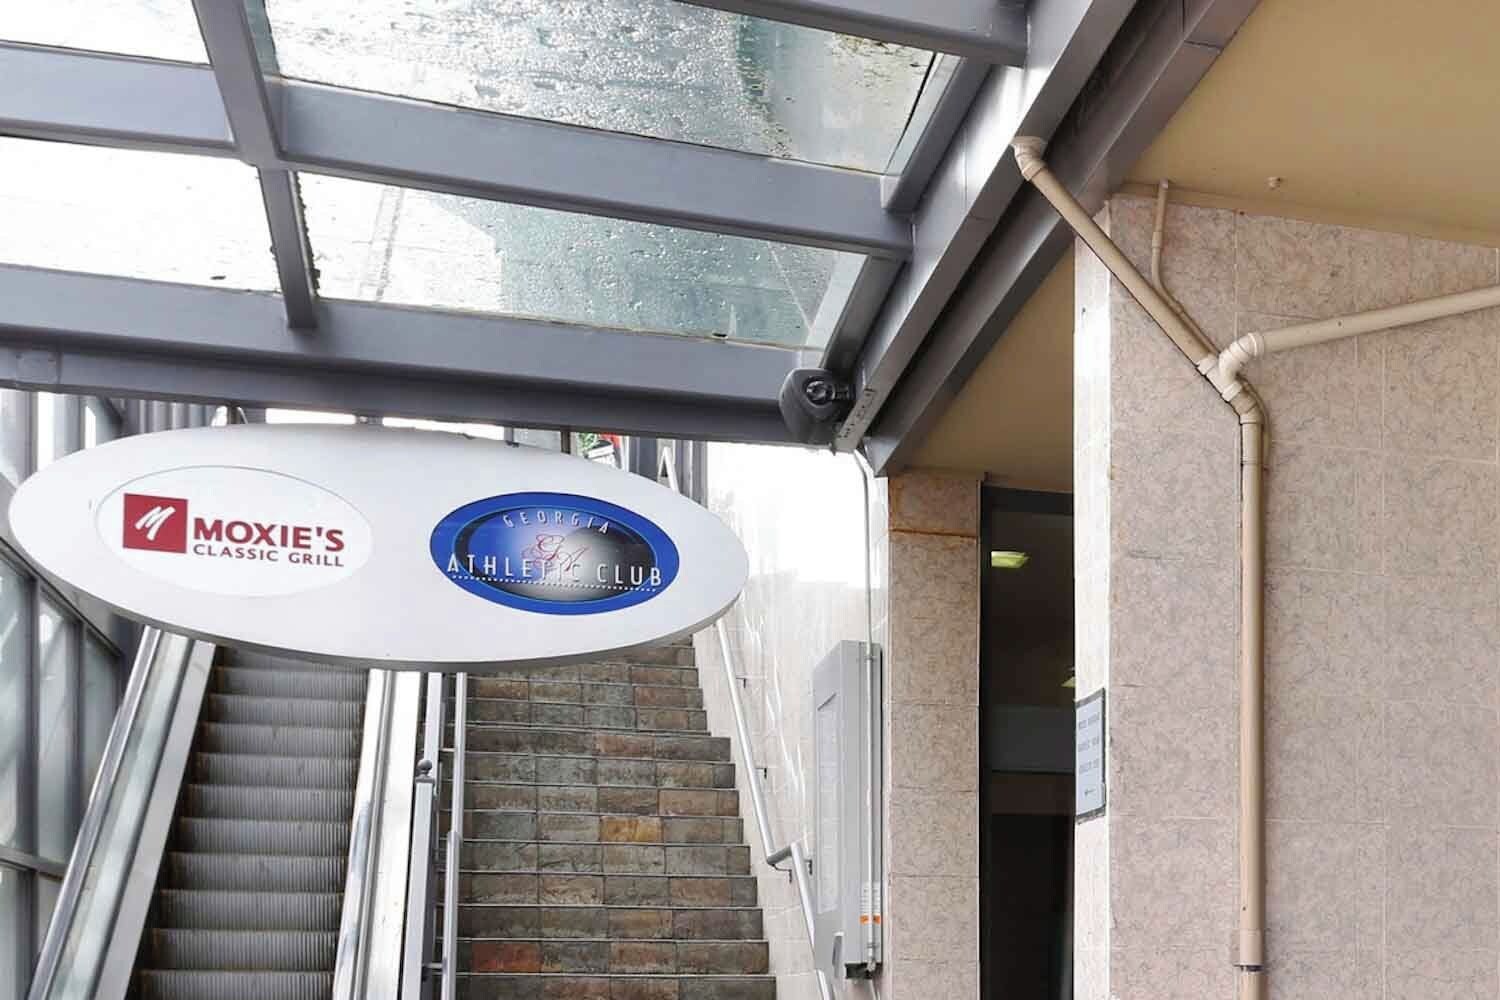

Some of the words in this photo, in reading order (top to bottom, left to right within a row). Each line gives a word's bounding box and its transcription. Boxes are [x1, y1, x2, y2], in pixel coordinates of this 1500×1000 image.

[193, 517, 345, 552] MOXIE'S
[503, 510, 610, 534] GEORGIA
[193, 544, 279, 562] CLASSIC
[288, 552, 345, 567] GRILL
[447, 554, 582, 584] ATHLETIC
[596, 563, 662, 587] CLUB
